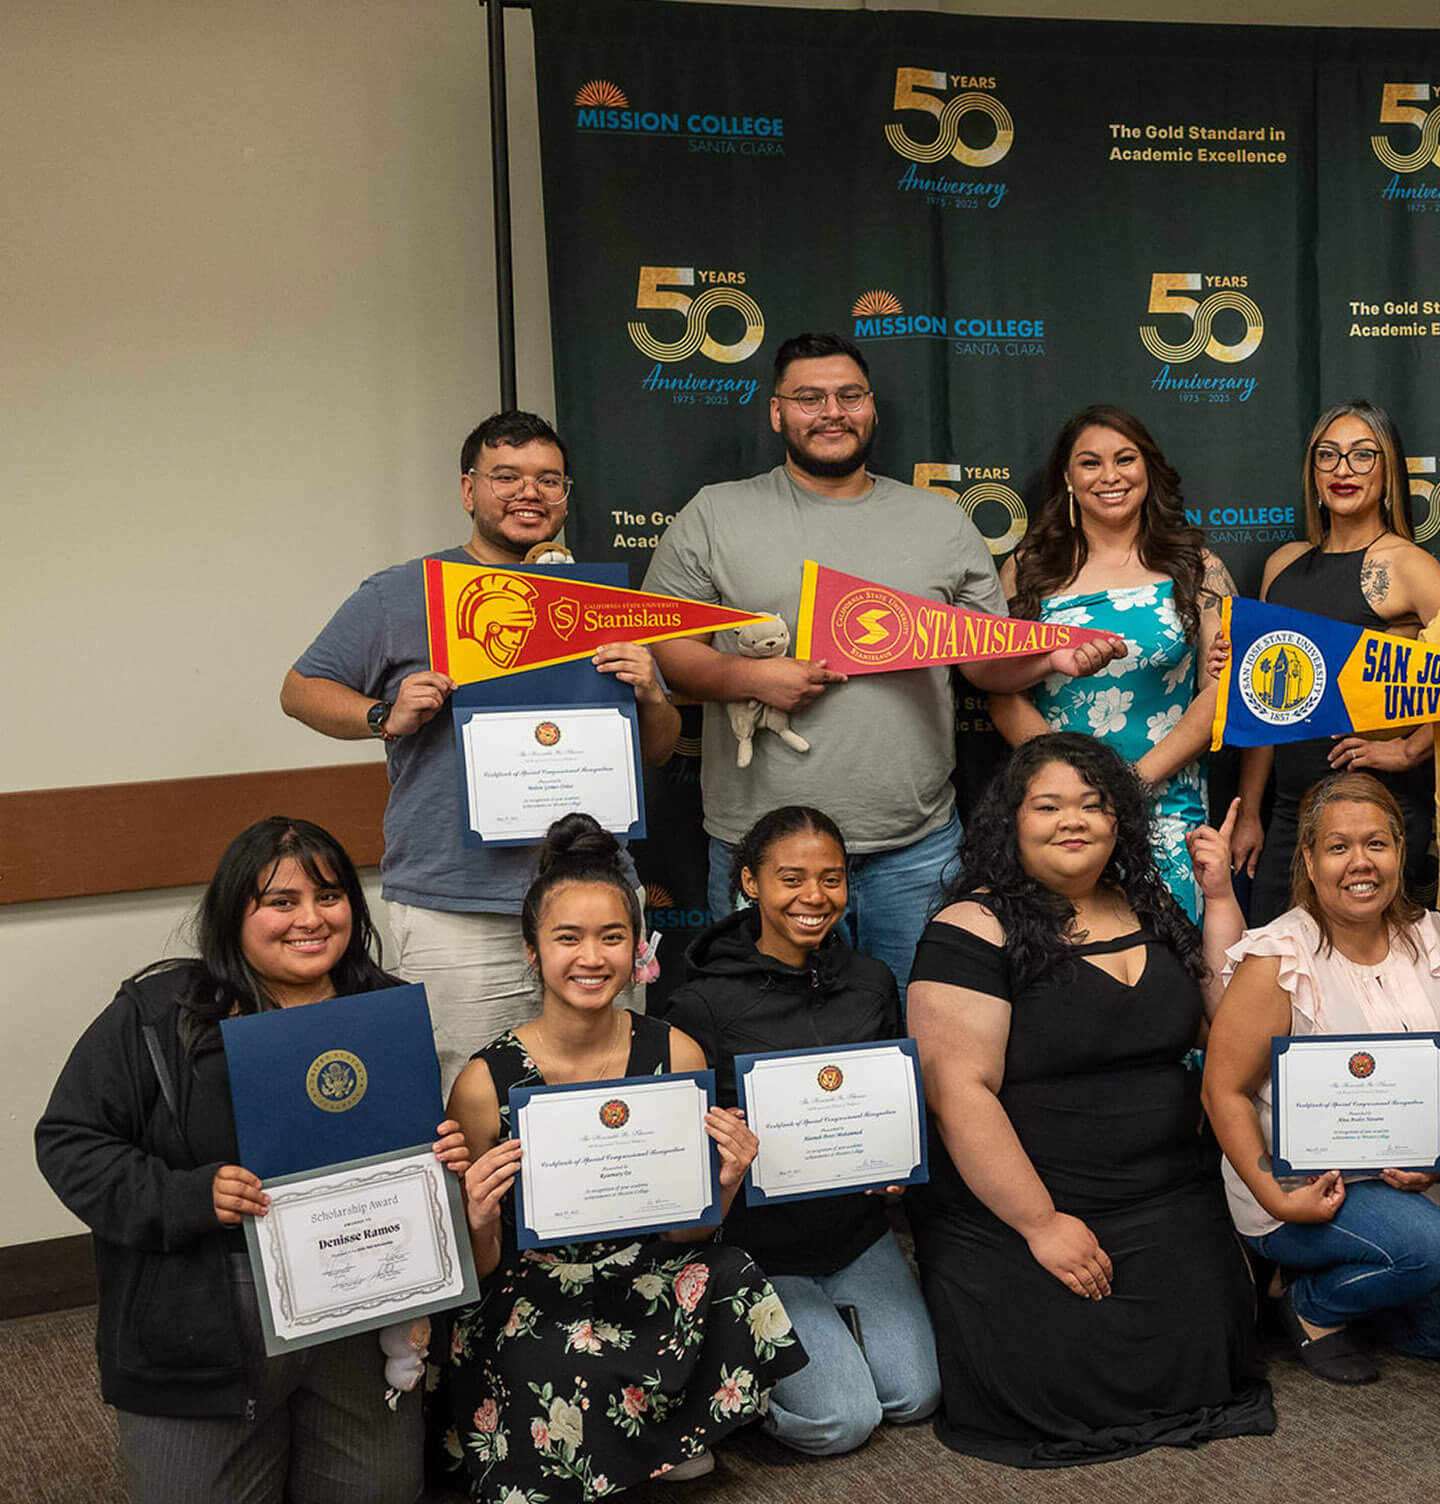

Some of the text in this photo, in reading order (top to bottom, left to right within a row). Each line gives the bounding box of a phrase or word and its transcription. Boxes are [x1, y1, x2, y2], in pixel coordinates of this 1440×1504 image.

[951, 75, 996, 89] YEARS
[577, 109, 784, 137] MISSION COLLEGE
[884, 67, 1015, 168] 50
[1109, 124, 1286, 141] The Gold Standard in
[688, 139, 784, 155] SANTA CLARA
[1109, 147, 1287, 163] Academic Excellence
[897, 163, 1008, 209] Anniversary
[698, 270, 747, 285] YEARS
[1205, 276, 1249, 288] YEARS
[627, 266, 765, 364] 50
[1139, 272, 1264, 364] 50
[1350, 301, 1380, 315] The
[1384, 301, 1418, 315] Gold
[854, 315, 1045, 337] MISSION COLLEGE
[1350, 322, 1427, 337] Academic
[954, 341, 1046, 356] SANTA CLARA
[642, 363, 760, 405] Anniversary
[1151, 363, 1258, 402] Anniversary
[672, 394, 696, 405] 1975
[965, 466, 1011, 480] YEARS
[611, 511, 646, 525] The
[1208, 506, 1295, 526] COLLEGE
[613, 533, 659, 548] Acad
[1210, 529, 1296, 545] SANTA CLARA
[584, 608, 682, 632] Stanislaus
[913, 606, 1071, 661] STANISLAUS
[1242, 633, 1324, 696] SAN JOSE STATE UNIVERSITY
[1363, 638, 1411, 686] SAN
[646, 909, 713, 929] ISSIO
[311, 1202, 368, 1224] Scholarship
[369, 1194, 399, 1211] Award
[318, 1232, 361, 1250] Denisse
[364, 1223, 401, 1239] Ramos
